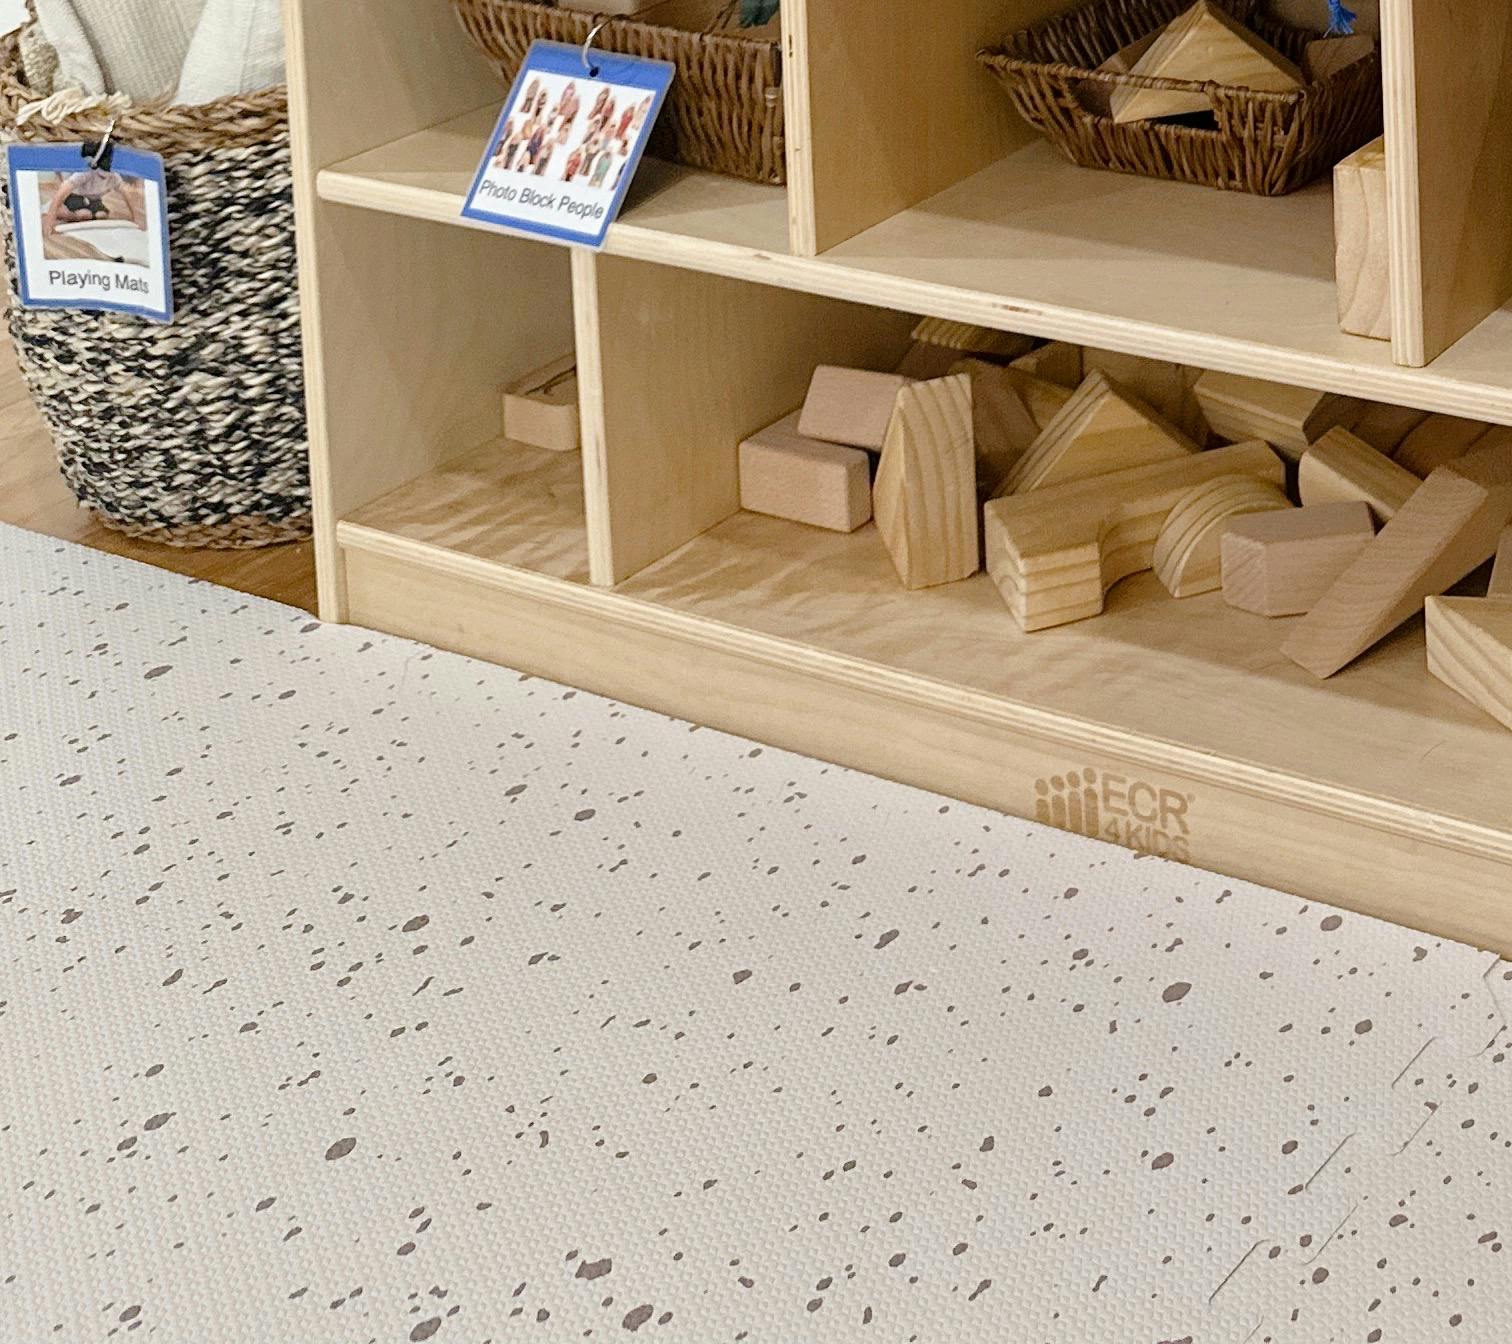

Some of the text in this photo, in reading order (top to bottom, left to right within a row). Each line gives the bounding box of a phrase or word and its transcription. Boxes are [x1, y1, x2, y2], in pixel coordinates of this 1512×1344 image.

[479, 179, 604, 220] Photo Block People
[49, 269, 150, 294] Playing Mats
